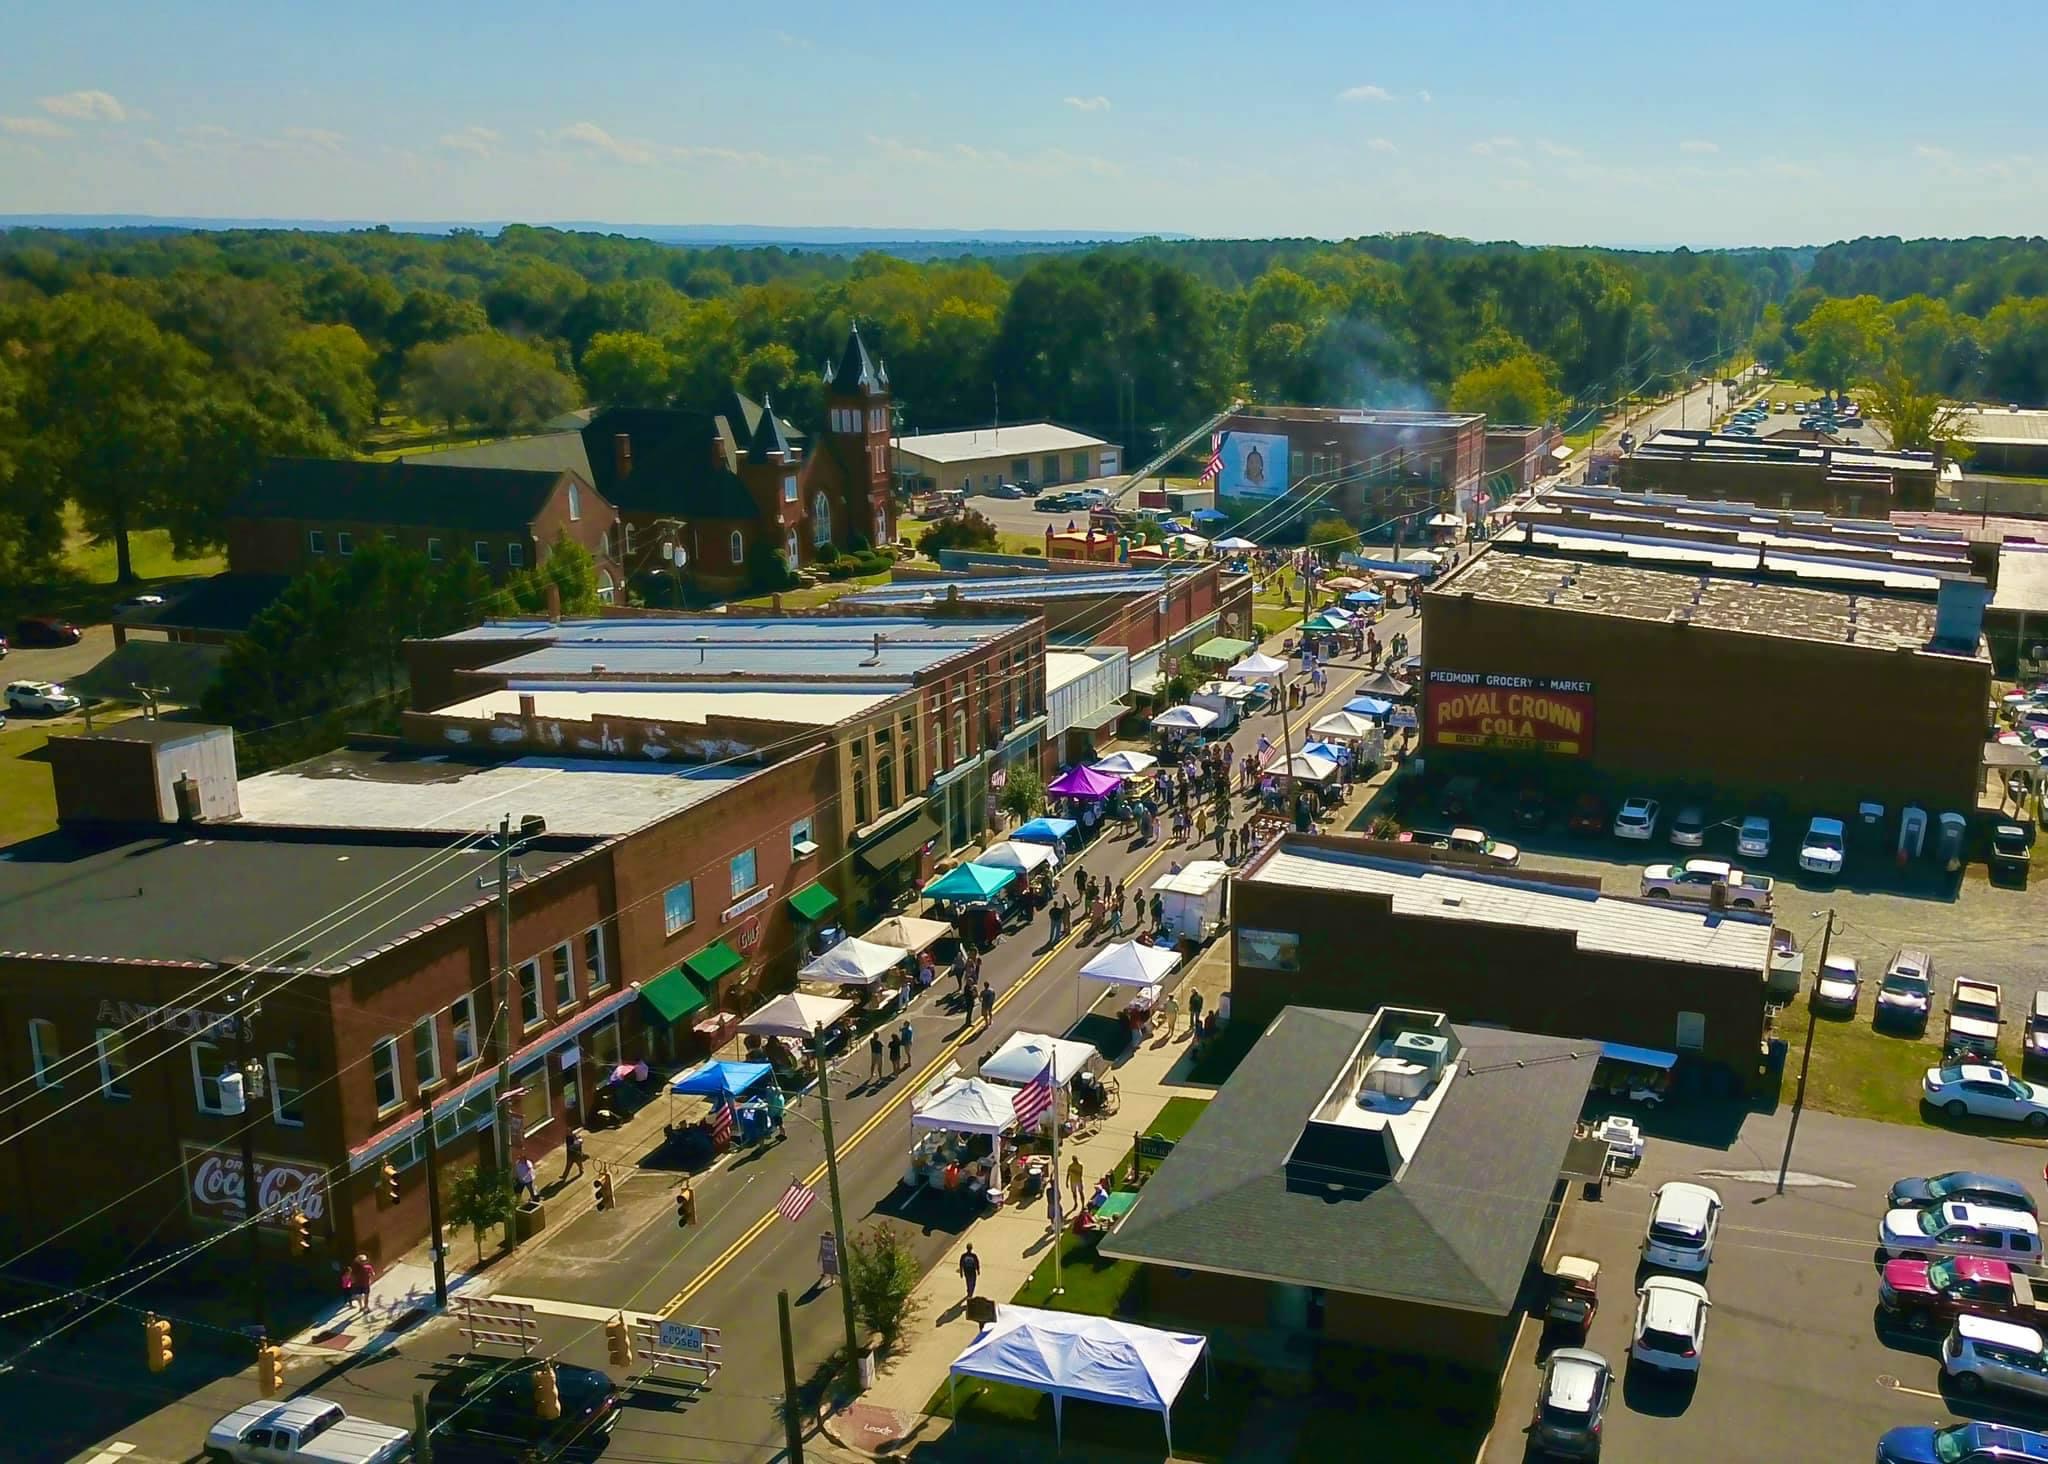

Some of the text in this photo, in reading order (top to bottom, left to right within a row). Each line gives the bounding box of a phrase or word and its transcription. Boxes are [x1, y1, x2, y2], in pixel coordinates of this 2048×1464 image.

[1430, 671, 1481, 684] PIEDMONT
[1486, 675, 1534, 688] GROCERY
[1550, 679, 1592, 692] MARKET
[1438, 692, 1582, 734] ROYAL CROWN
[1481, 718, 1535, 738] COLA
[741, 926, 760, 949] GULF
[96, 1000, 254, 1042] ANTIQUES
[224, 1158, 264, 1174] DRK
[669, 1326, 693, 1337] ROAD
[662, 1336, 699, 1348] CLOSED
